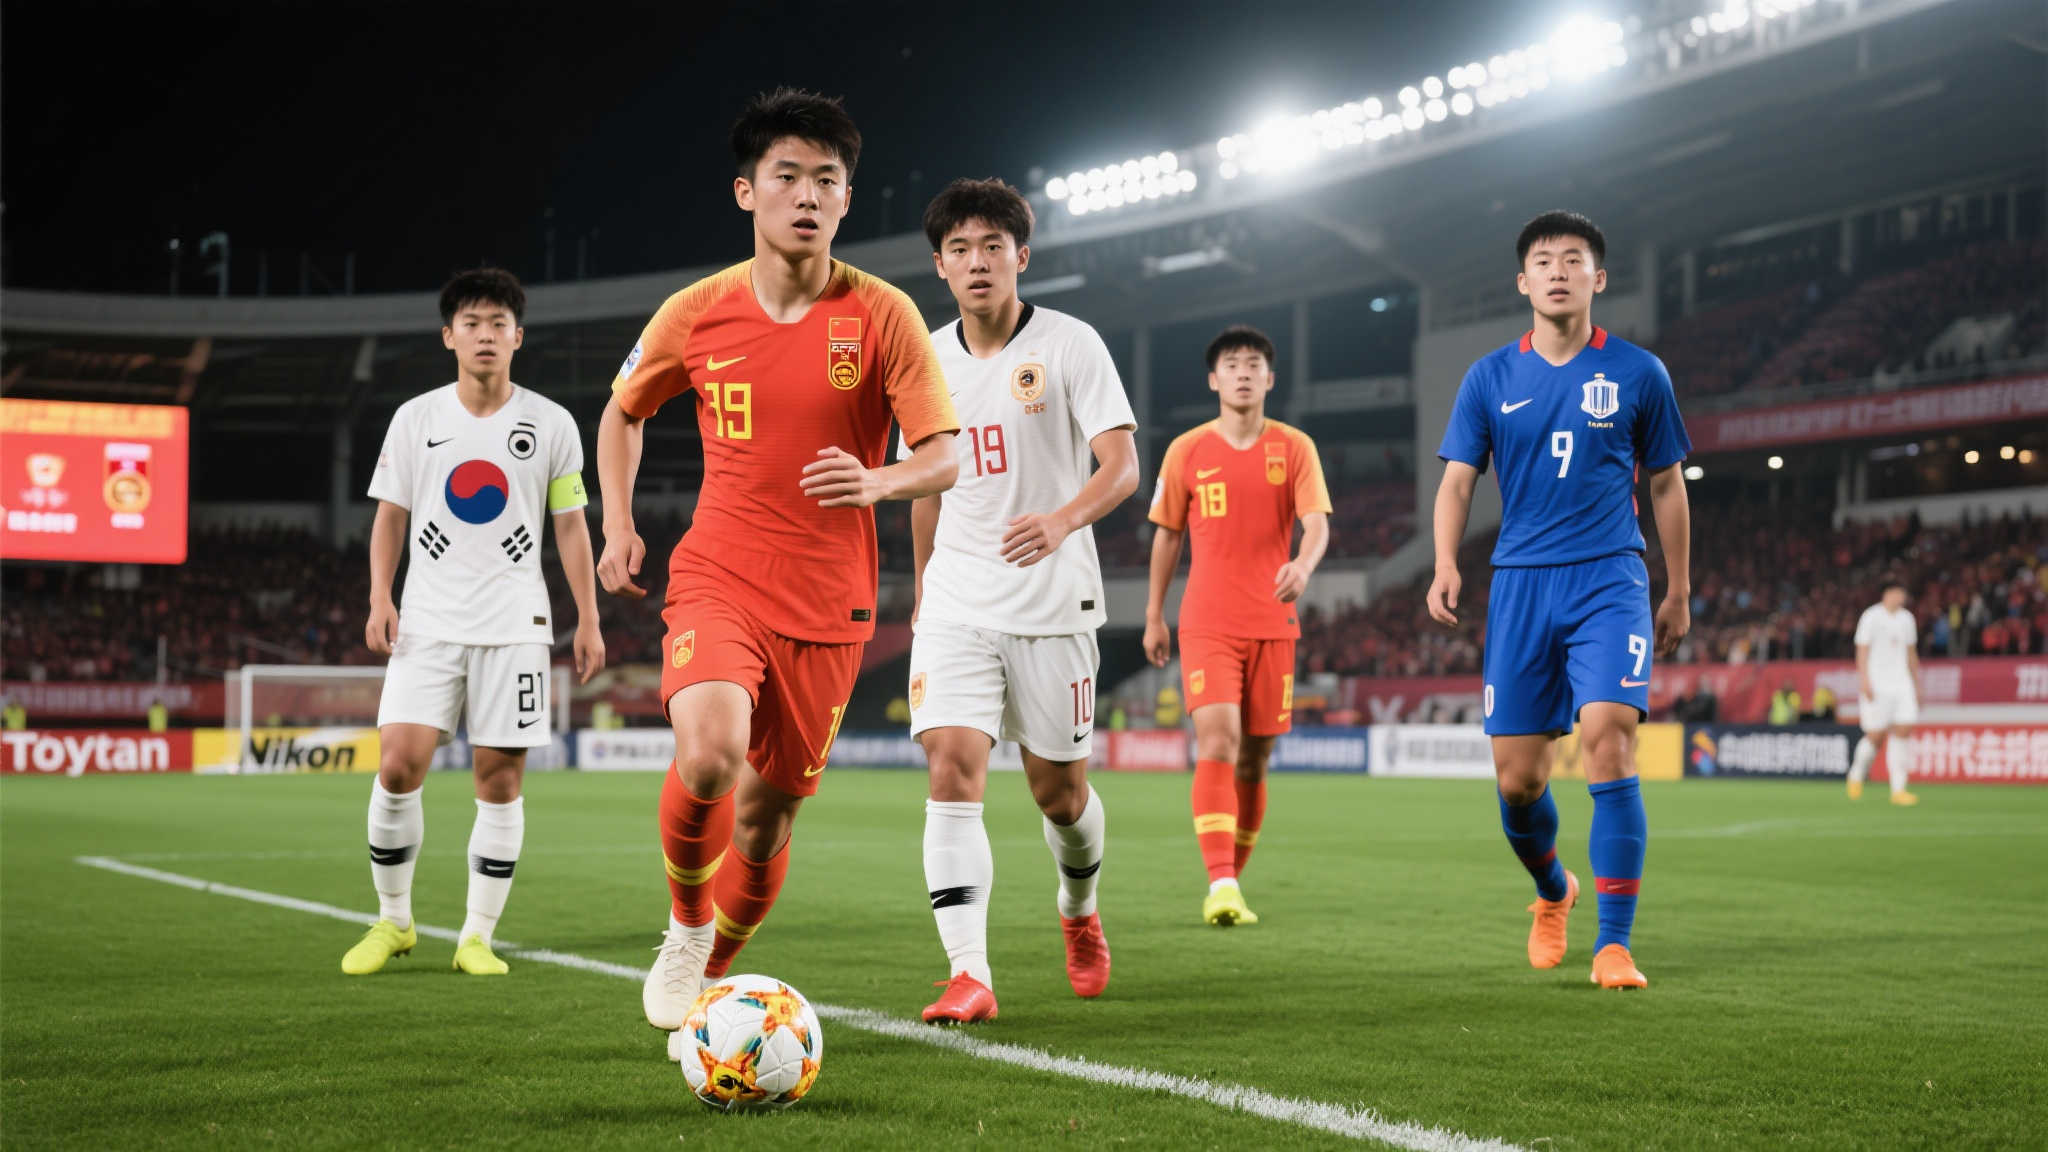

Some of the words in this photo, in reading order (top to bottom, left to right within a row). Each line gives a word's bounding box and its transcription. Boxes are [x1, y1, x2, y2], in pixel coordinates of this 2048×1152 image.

[968, 424, 1007, 477] 19
[1552, 431, 1573, 478] 9
[1196, 482, 1227, 518] 18
[1628, 634, 1647, 676] 9
[518, 672, 544, 712] 21
[1071, 677, 1091, 726] 10
[2, 731, 170, 777] Toytan
[248, 737, 357, 768] Nikon
